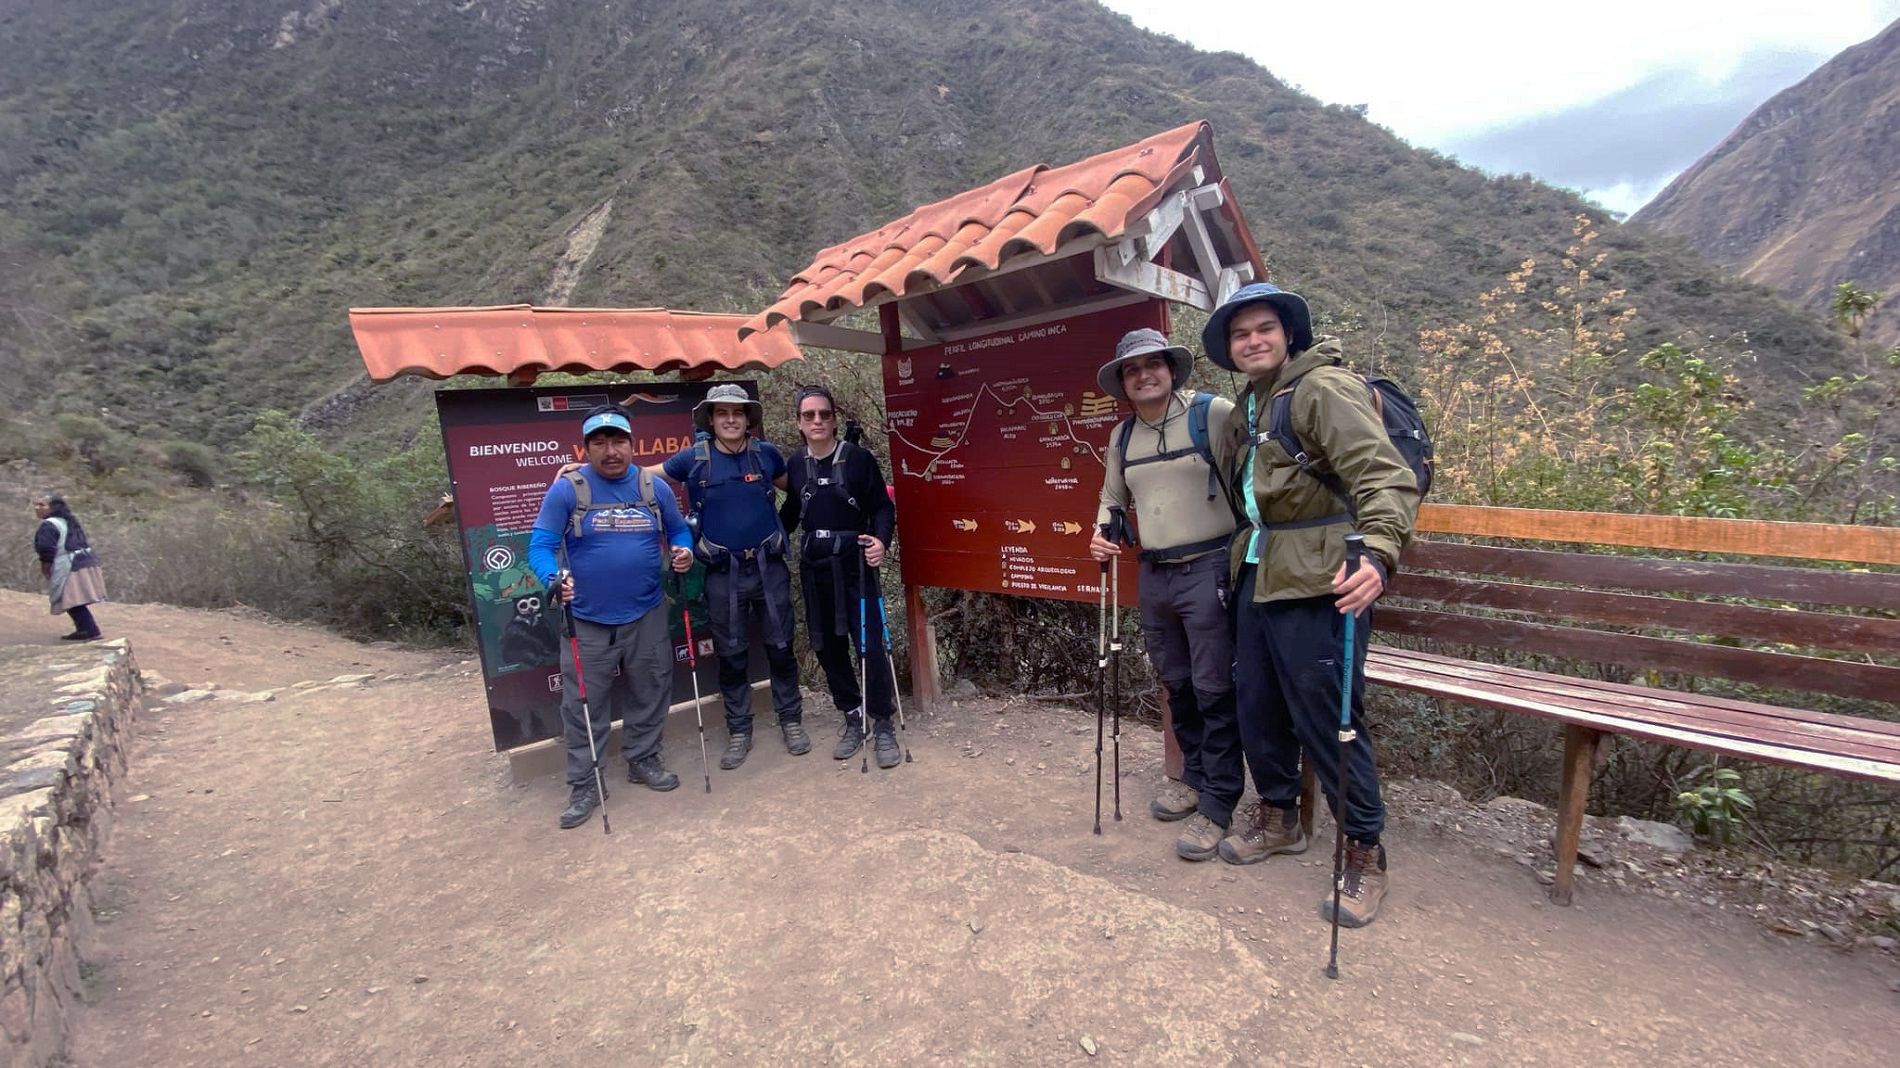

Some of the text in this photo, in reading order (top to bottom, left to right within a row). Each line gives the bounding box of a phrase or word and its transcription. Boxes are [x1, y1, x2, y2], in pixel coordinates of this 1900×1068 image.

[1018, 328, 1047, 342] CAMINO
[1047, 324, 1067, 335] INCA
[470, 440, 559, 457] BIENVENIDO
[516, 454, 573, 467] WELCOME
[489, 485, 515, 493] BOSQUE
[1001, 545, 1028, 553] LEYENDA
[1009, 564, 1036, 572] COMPLEJO
[1038, 583, 1067, 592] VIGILANCIA
